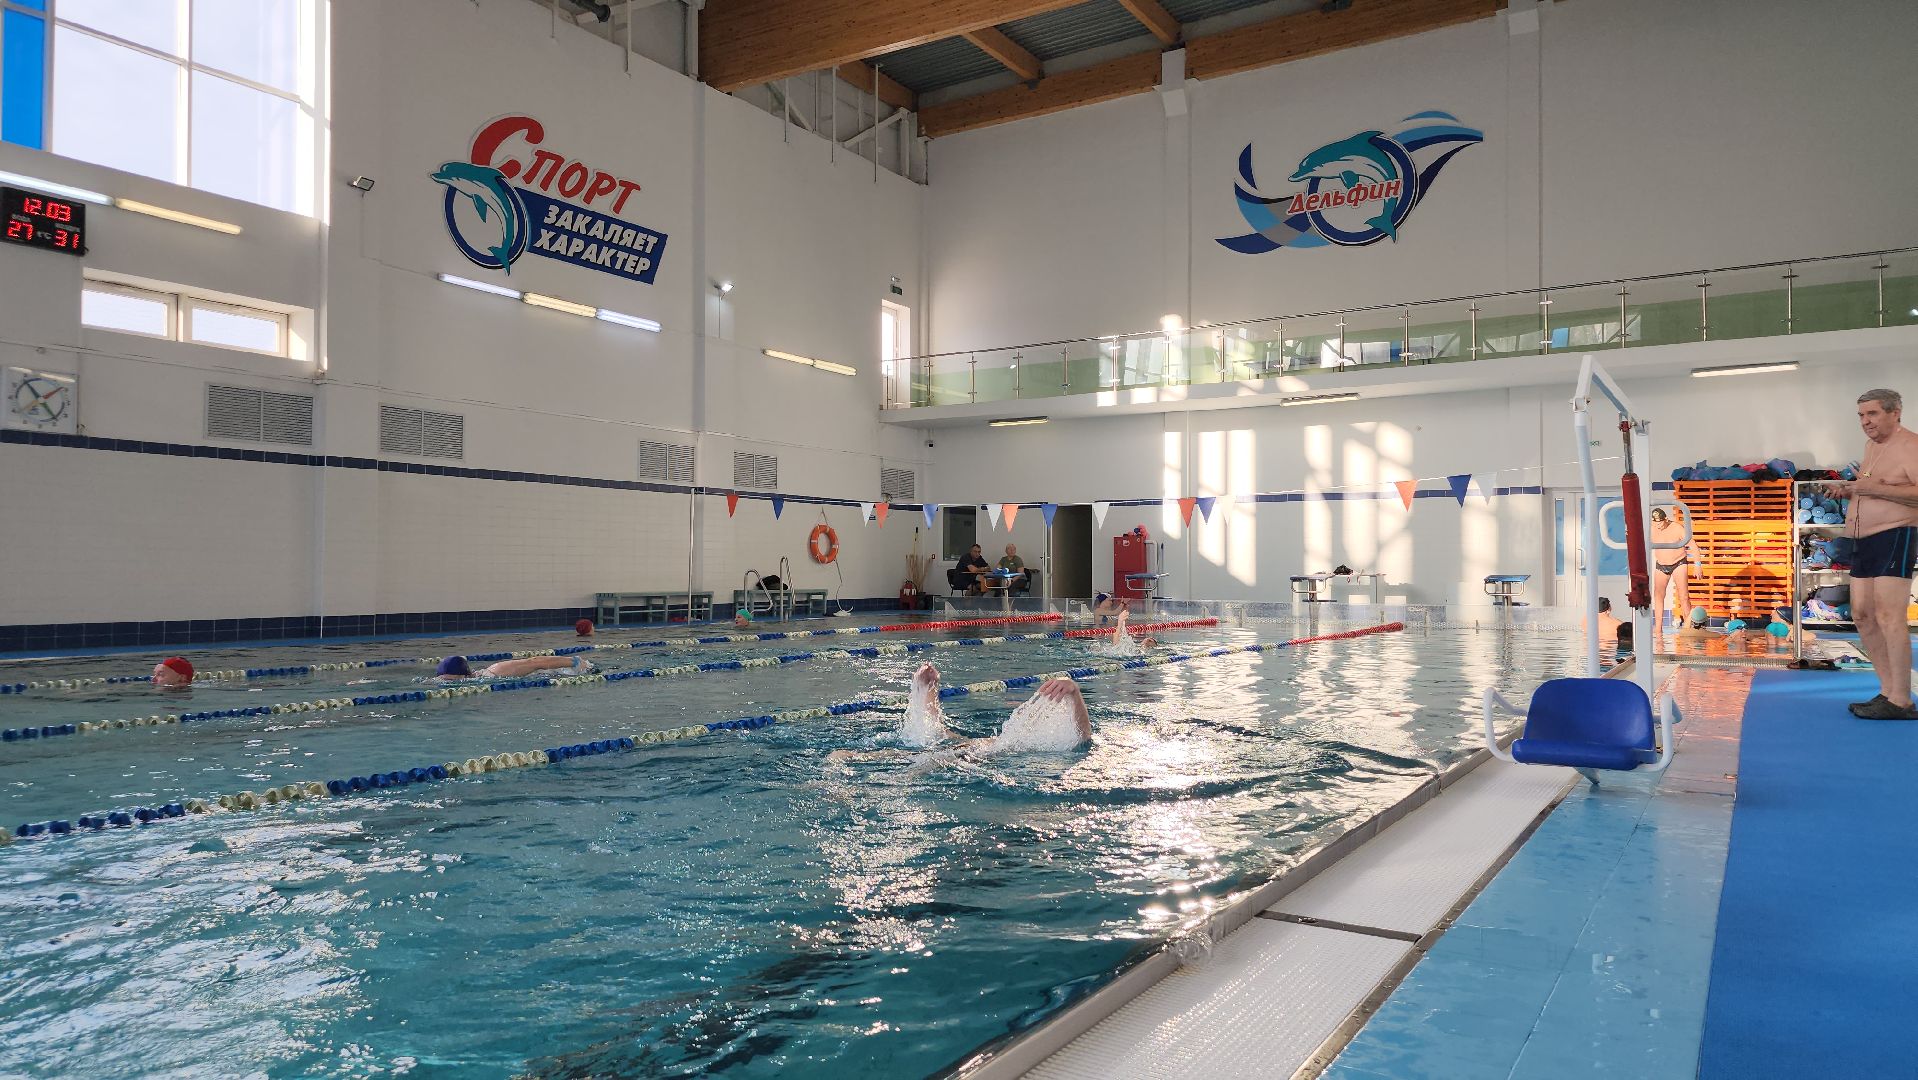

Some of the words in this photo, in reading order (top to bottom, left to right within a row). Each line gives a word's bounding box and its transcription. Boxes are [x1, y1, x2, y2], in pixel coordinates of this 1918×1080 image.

[1288, 178, 1401, 215] Дельфин
[7, 220, 34, 241] 27
[55, 229, 80, 249] 31
[543, 204, 659, 255] ЗАКАЛЯЕТ
[534, 228, 651, 276] ХАРАКТЕР
